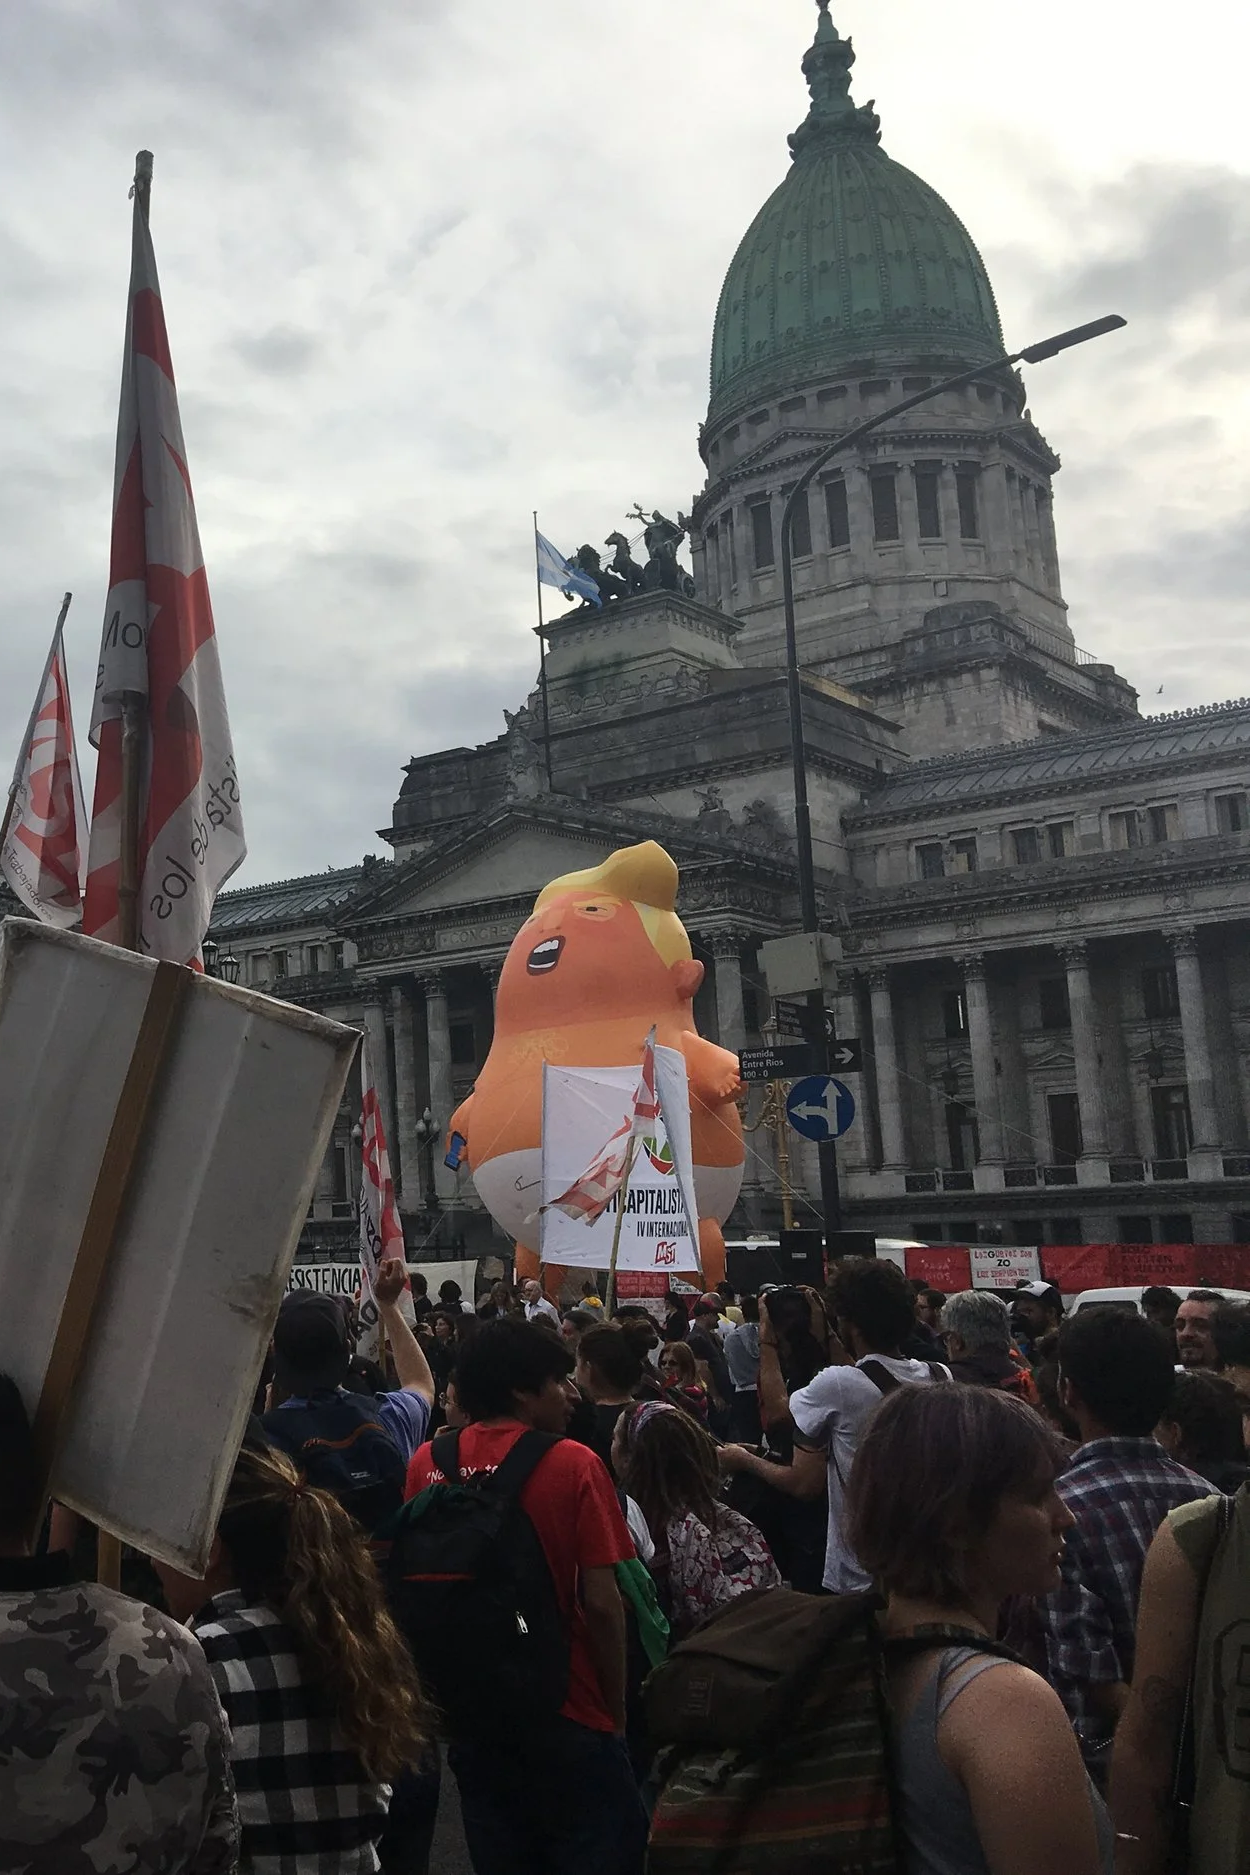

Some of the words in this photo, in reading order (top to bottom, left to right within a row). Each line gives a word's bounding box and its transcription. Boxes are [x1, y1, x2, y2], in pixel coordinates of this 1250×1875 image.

[742, 1049, 774, 1059] Avenida
[742, 1060, 764, 1069] Entre
[285, 1267, 362, 1294] ESISTENCIA
